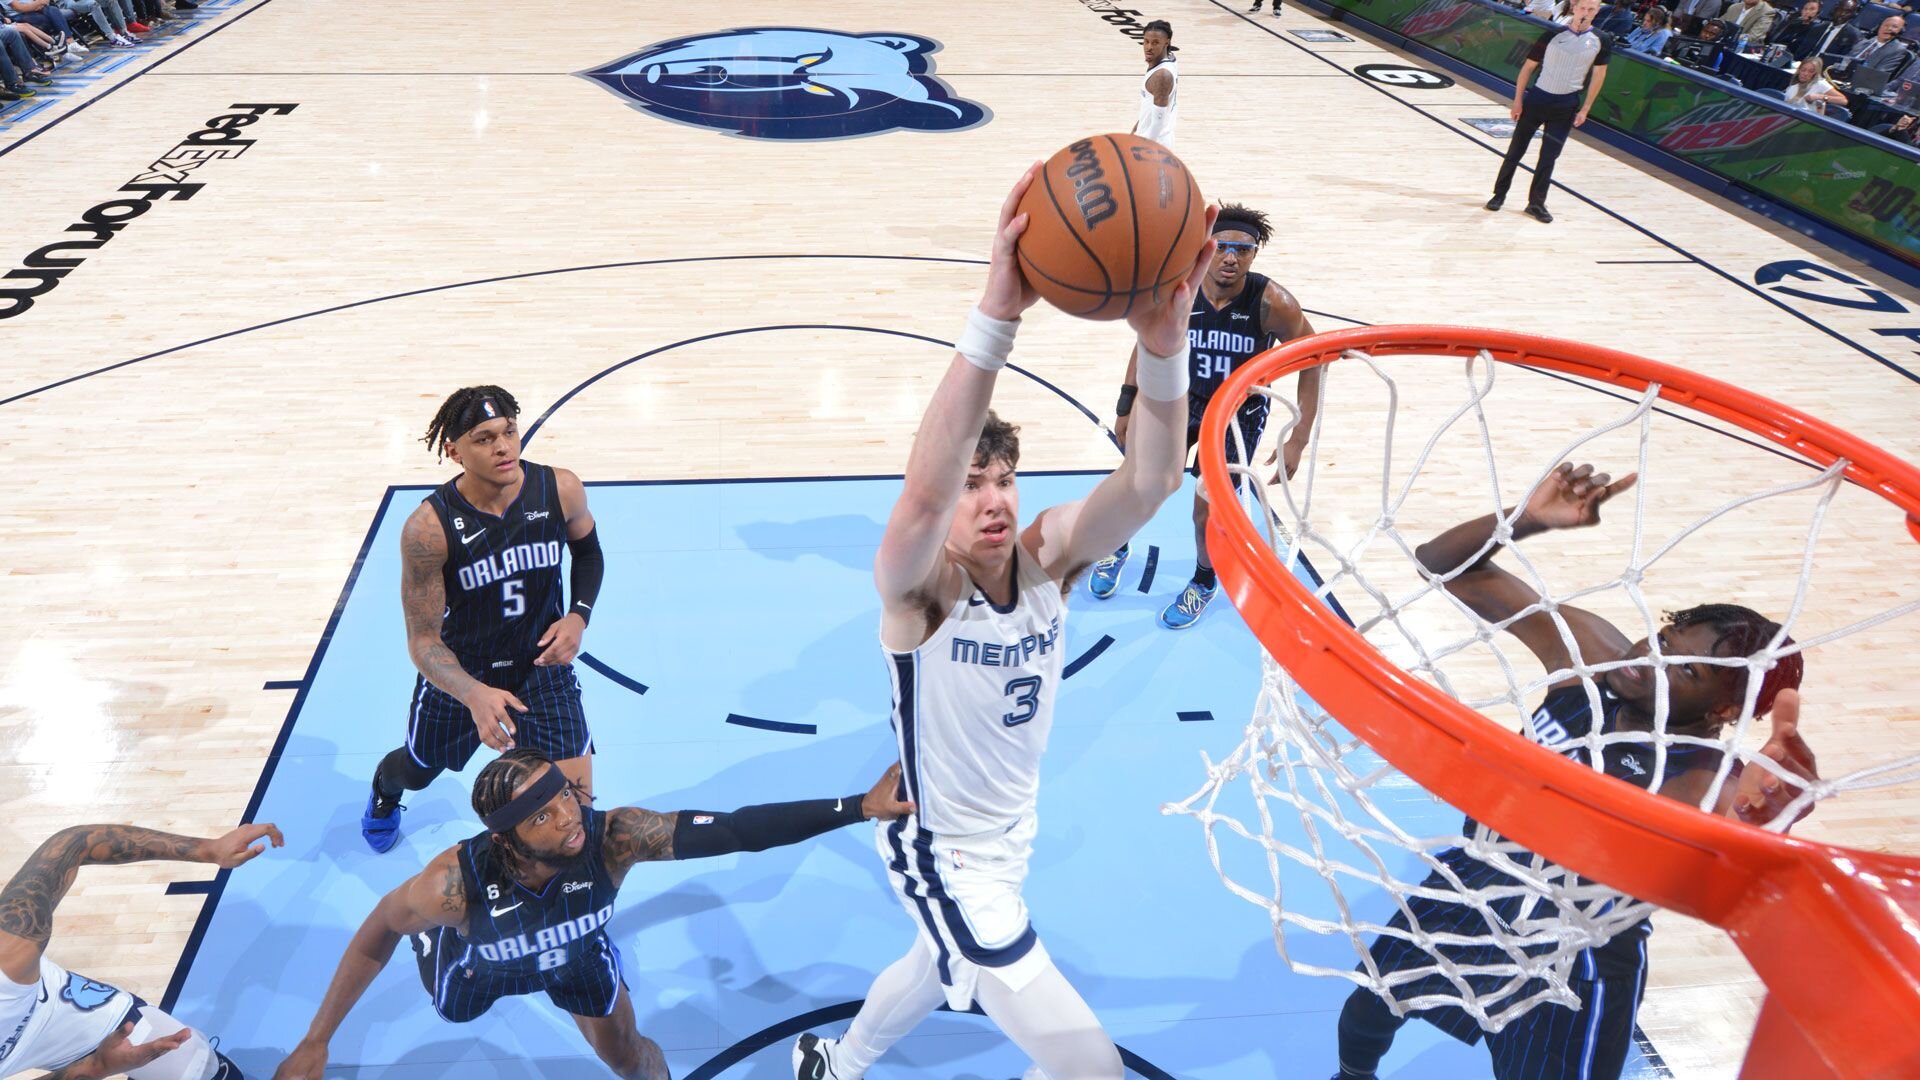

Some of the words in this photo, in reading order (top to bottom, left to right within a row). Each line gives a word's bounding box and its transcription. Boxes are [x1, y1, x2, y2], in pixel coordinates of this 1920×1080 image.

[1230, 312, 1250, 321] Disney
[1187, 329, 1255, 354] RLANDO
[1196, 353, 1231, 379] 34
[453, 517, 465, 530] 6
[524, 510, 550, 521] Disney
[458, 541, 560, 591] ORLANDO
[502, 579, 526, 618] 5
[1002, 675, 1042, 728] 3
[486, 883, 500, 900] 6
[561, 880, 594, 894] Disney
[477, 903, 613, 962] ORLANDO
[538, 948, 569, 972] 8
